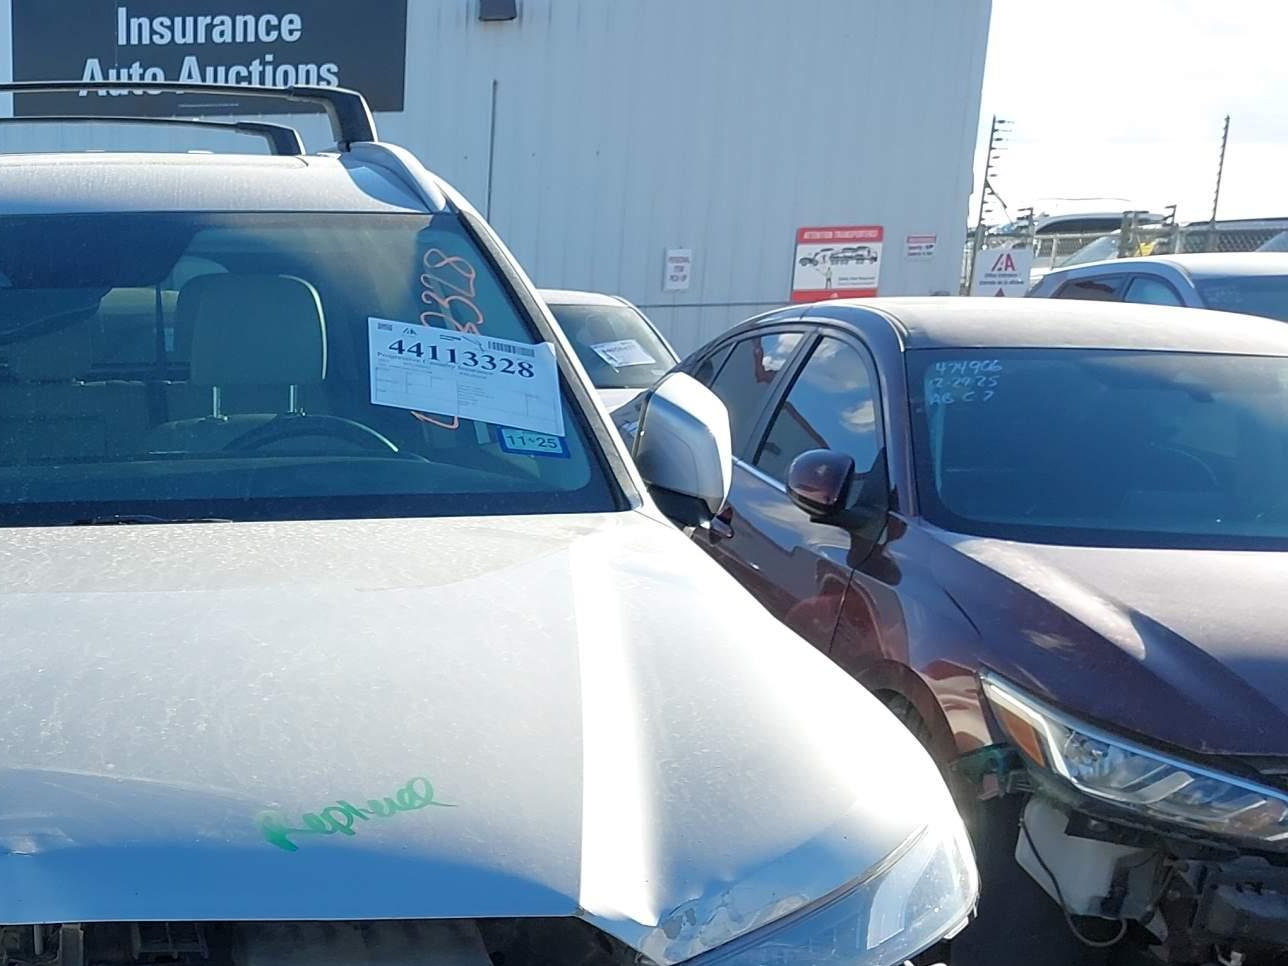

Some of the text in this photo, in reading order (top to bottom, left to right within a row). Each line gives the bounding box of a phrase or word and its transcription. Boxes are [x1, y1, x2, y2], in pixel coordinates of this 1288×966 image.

[117, 7, 302, 45] Insurance
[79, 54, 339, 96] Auto Auctions
[388, 339, 535, 378] 44113328
